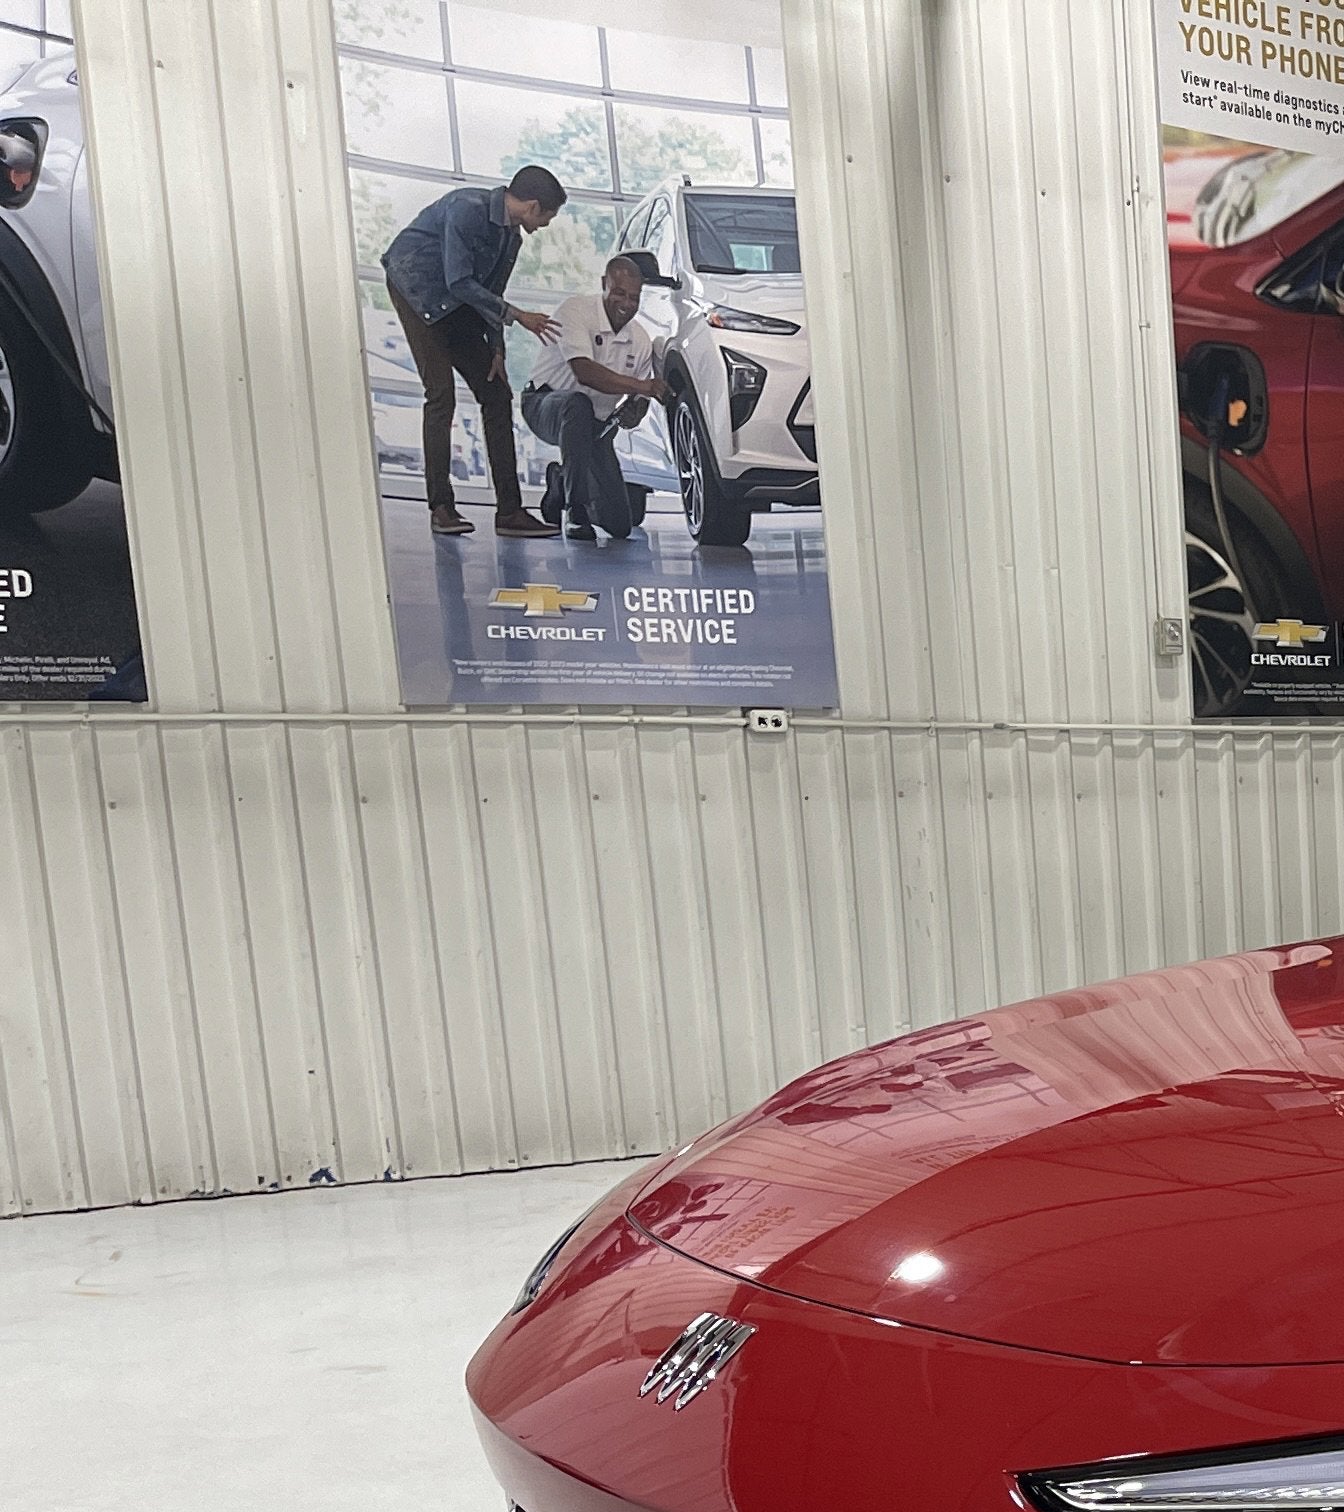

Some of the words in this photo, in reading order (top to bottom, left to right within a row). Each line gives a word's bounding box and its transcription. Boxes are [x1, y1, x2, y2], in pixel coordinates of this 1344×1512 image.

[1178, 20, 1253, 66] YOUR
[1181, 69, 1210, 89] View
[1213, 78, 1270, 101] real-time
[1273, 88, 1340, 116] diagnostics
[1220, 99, 1272, 121] available
[1275, 112, 1290, 124] on
[1292, 113, 1312, 129] the
[623, 586, 756, 615] CERTIFIED
[486, 624, 607, 642] CHEVROLET
[626, 617, 738, 645] SERVICE
[1250, 653, 1332, 667] CHEVROLET
